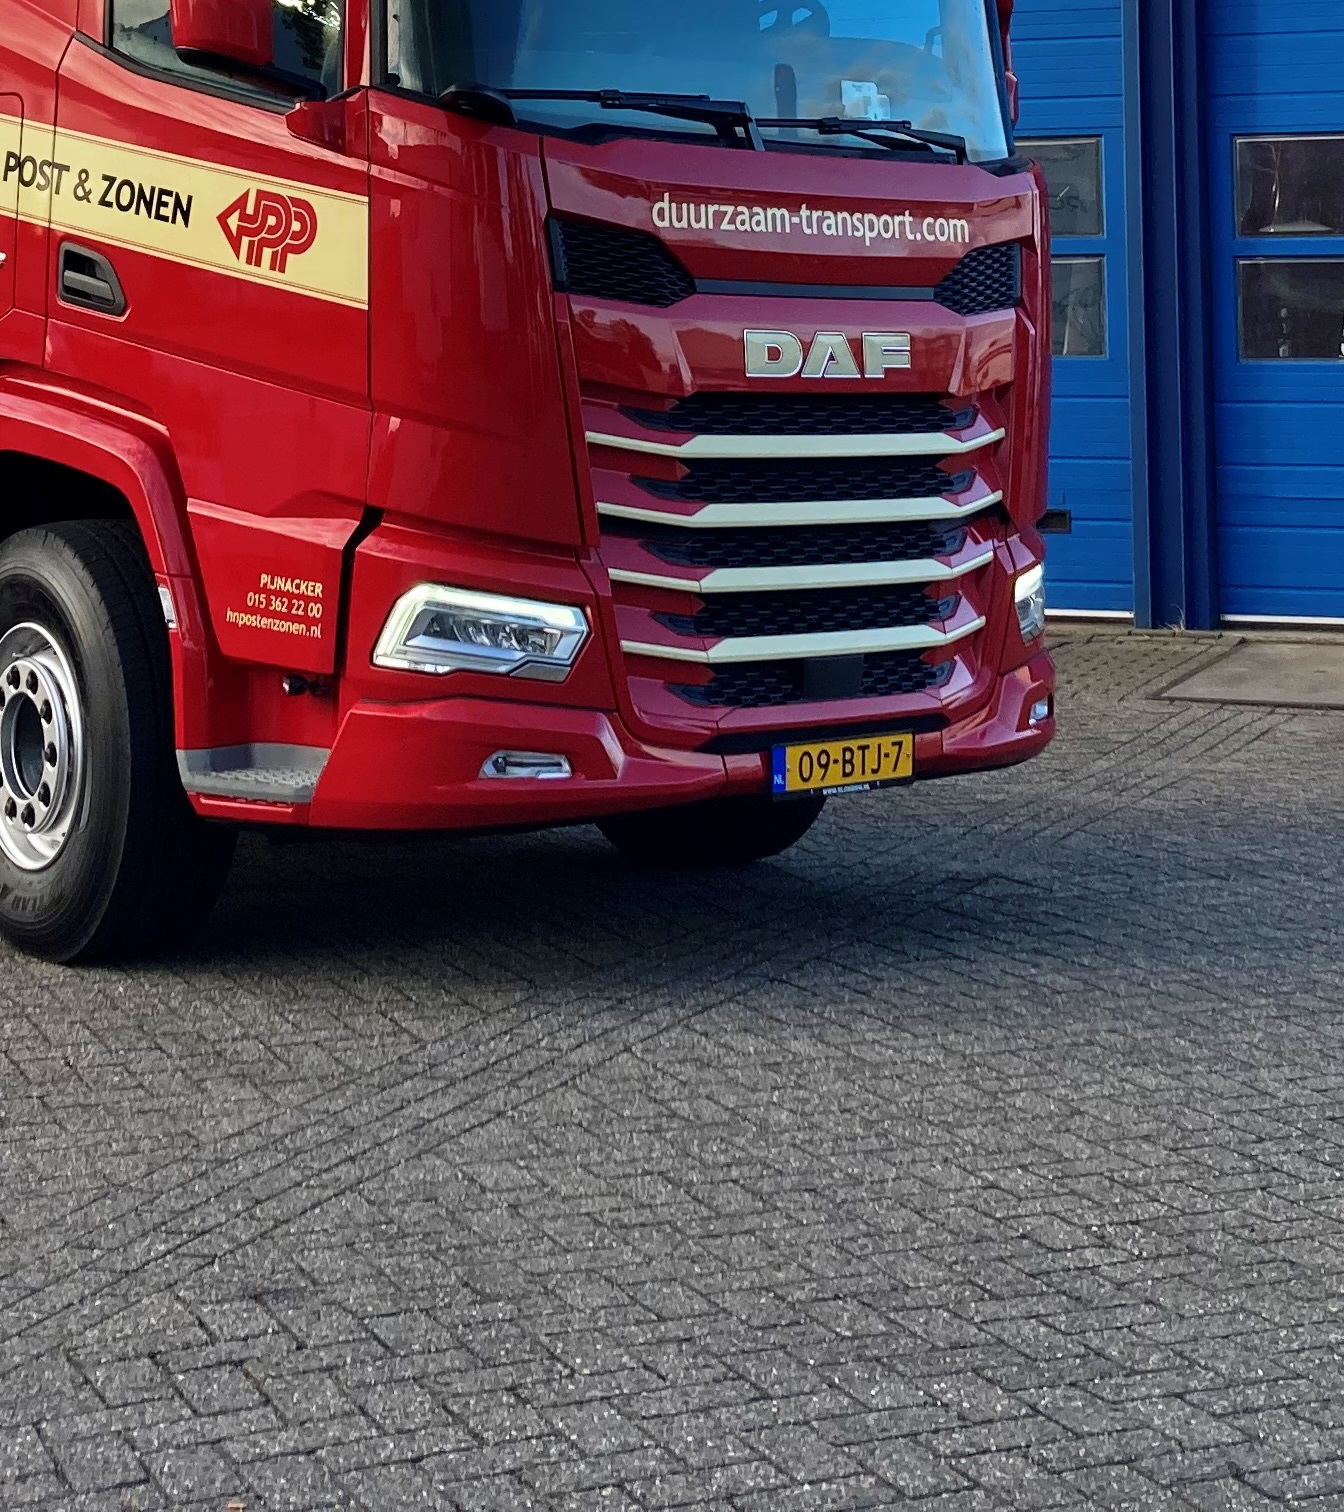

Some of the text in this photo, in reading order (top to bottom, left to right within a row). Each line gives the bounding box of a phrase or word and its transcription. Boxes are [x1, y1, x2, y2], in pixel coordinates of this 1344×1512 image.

[3, 151, 71, 195] POST
[73, 168, 92, 203] &
[98, 173, 194, 229] ZONEN
[652, 192, 970, 246] duurzaam-transport.com
[743, 329, 911, 378] DAF
[260, 573, 323, 598] PIJNACKER
[226, 607, 322, 639] hnpostenzonen.nl
[247, 591, 322, 618] 015 362 22 00
[773, 773, 785, 785] NL
[798, 740, 904, 783] 09-BTJ-7
